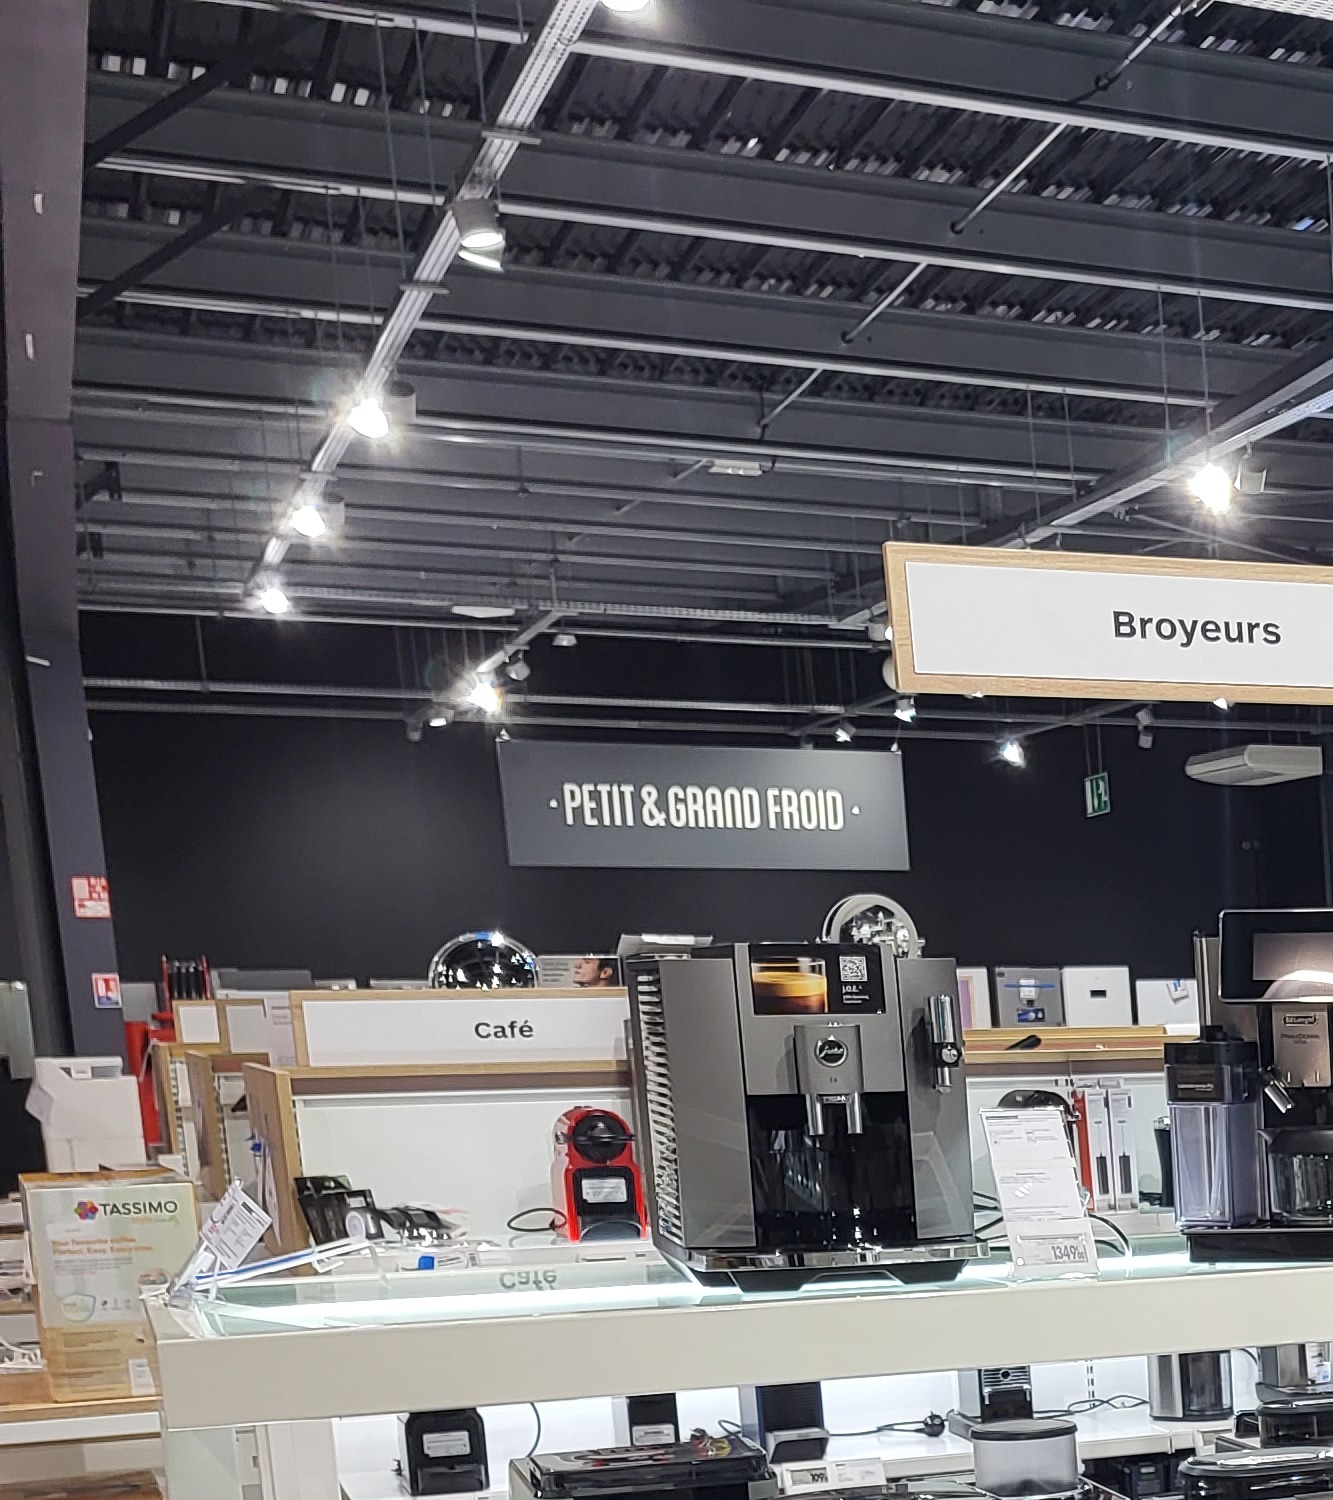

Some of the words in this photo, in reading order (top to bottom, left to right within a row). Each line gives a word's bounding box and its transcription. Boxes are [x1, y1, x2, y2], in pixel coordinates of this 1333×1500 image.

[1112, 610, 1283, 648] Broyeurs
[562, 781, 635, 827] PETIT
[640, 783, 667, 828] &
[667, 785, 762, 830] GRAND
[767, 787, 845, 831] FROID
[474, 1018, 535, 1039] Café
[99, 1200, 179, 1217] TASSIMO
